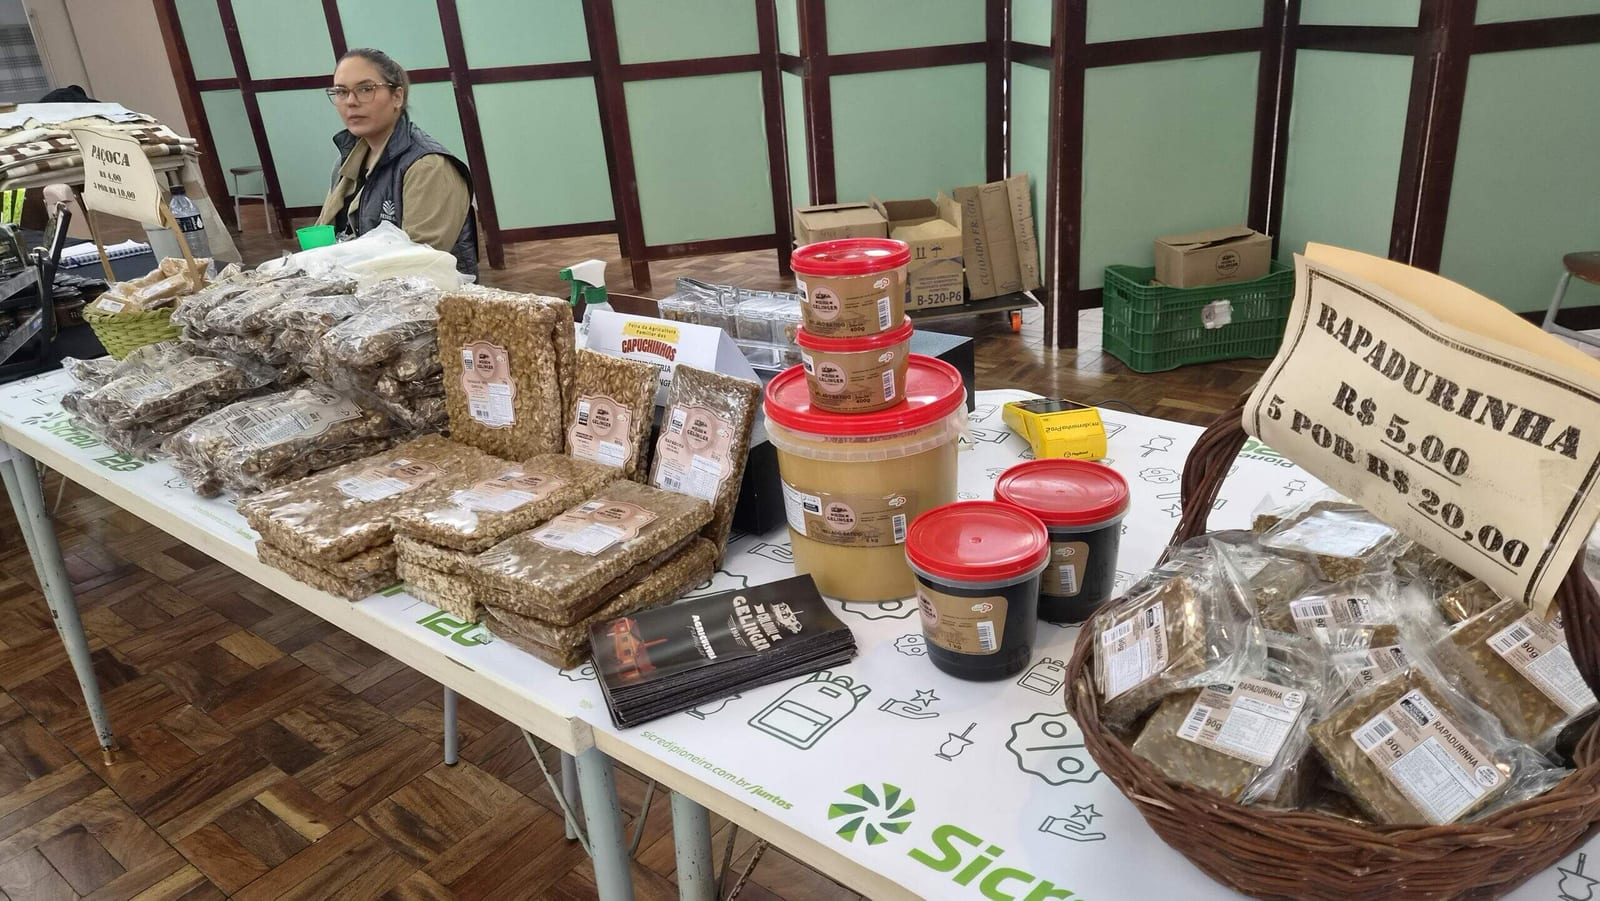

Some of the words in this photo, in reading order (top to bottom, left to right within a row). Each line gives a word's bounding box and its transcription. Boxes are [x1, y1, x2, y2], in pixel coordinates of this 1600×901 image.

[91, 145, 131, 167] PAÇOCA
[107, 173, 122, 182] 4,00
[98, 184, 109, 192] POR
[117, 188, 136, 199] 10,00
[917, 291, 962, 306] B-520-P6
[636, 329, 657, 337] Familiar
[649, 324, 677, 334] Agricultura
[622, 338, 677, 362] CAPUCHINHOS
[1316, 303, 1582, 460] RAPADURINHA
[1332, 381, 1378, 427] R$
[1384, 414, 1471, 477] 5,00
[1267, 394, 1286, 421] 5
[1290, 409, 1357, 465] POR
[1366, 452, 1410, 495] R$
[1417, 488, 1530, 568] 20,00
[732, 595, 771, 652] GELINGER
[1117, 637, 1126, 652] 90g
[1521, 642, 1539, 658] 90g
[1238, 682, 1283, 700] RAPADURINHA
[1205, 718, 1223, 731] 90g
[1384, 738, 1402, 758] 90g
[1433, 720, 1479, 768] RAPADURINHA
